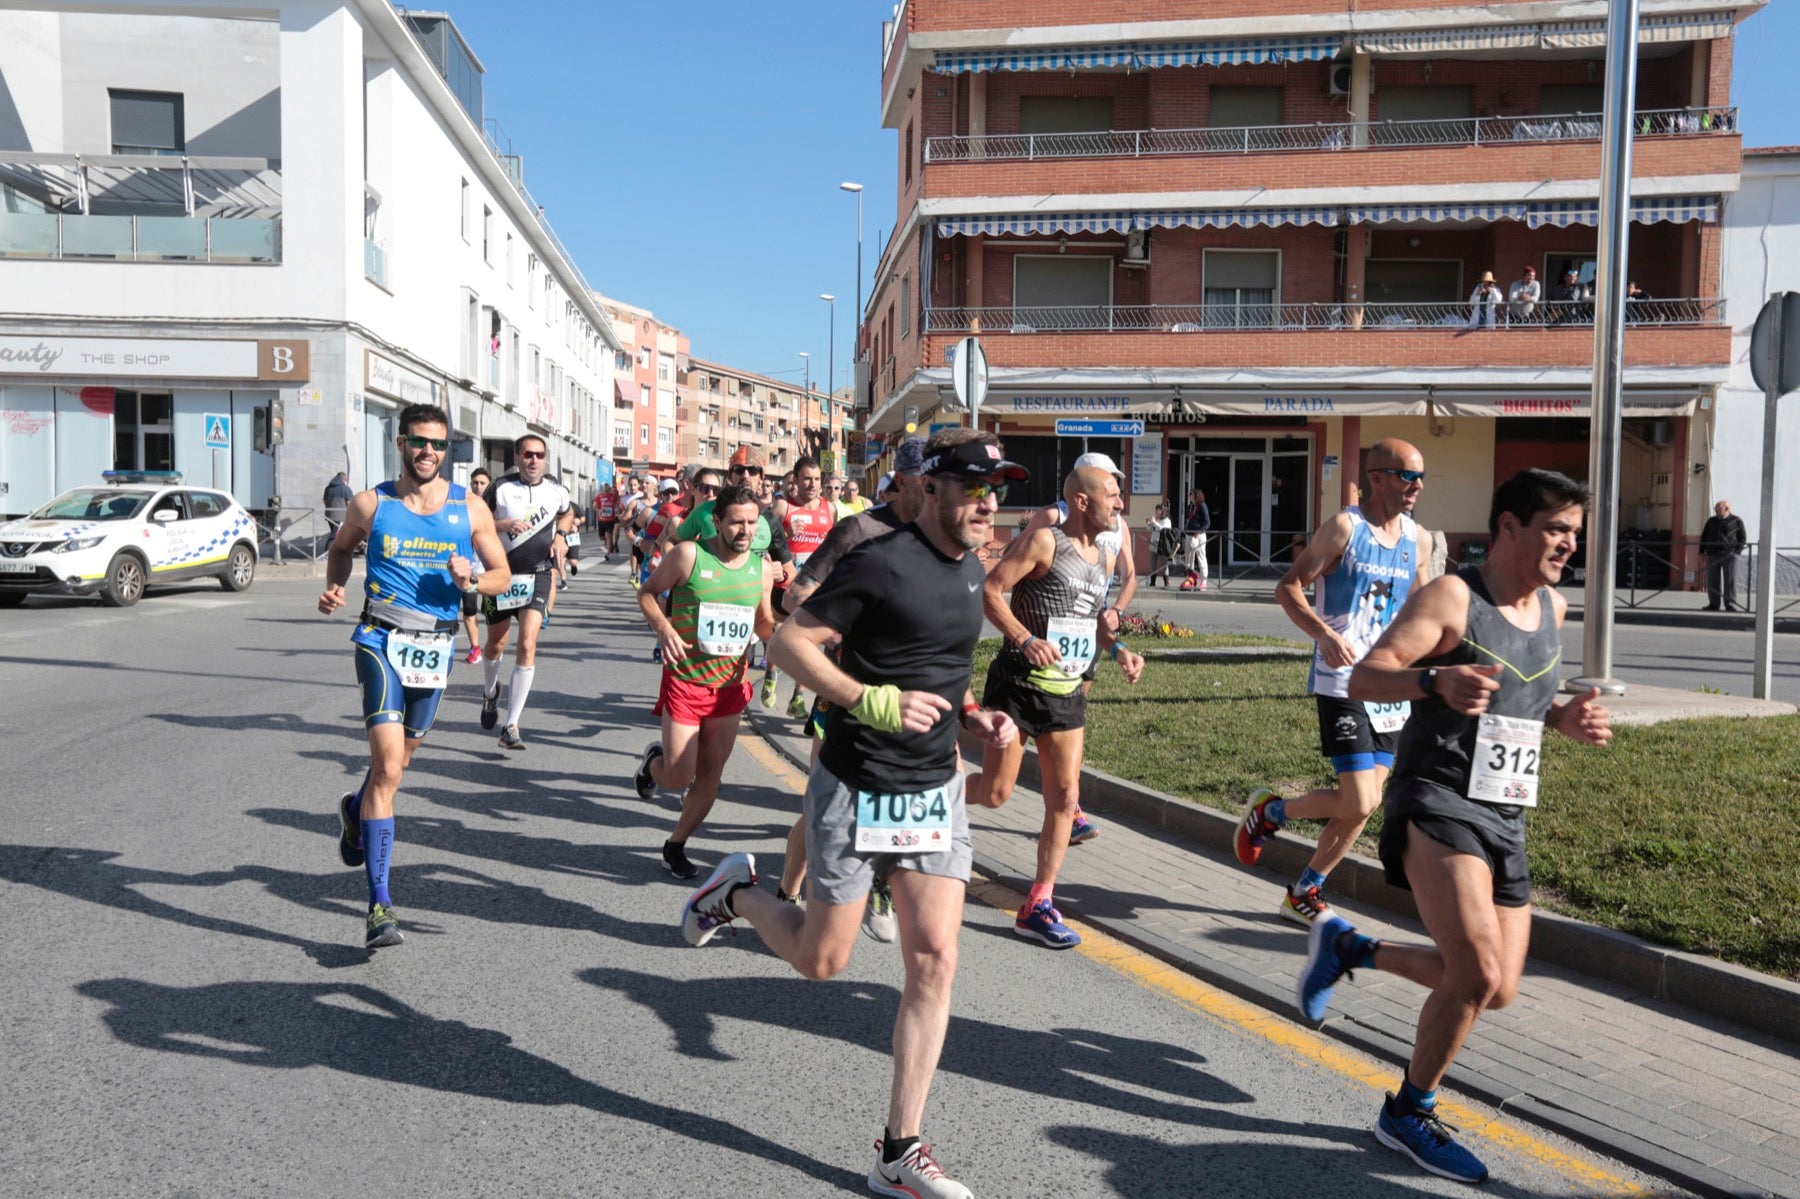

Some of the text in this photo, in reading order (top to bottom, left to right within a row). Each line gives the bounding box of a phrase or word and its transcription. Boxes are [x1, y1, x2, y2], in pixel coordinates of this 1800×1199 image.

[0, 341, 171, 371] auty THE SHOP
[271, 346, 295, 373] B
[1013, 396, 1130, 411] RESTAURANTE
[1263, 397, 1335, 411] PARADA
[1058, 423, 1094, 432] Granada
[1131, 411, 1207, 424] BICHITOS
[403, 537, 457, 553] olimpo
[1355, 562, 1388, 577] TODO
[706, 620, 749, 639] 1190
[1059, 636, 1089, 658] 812
[397, 646, 440, 670] 183
[1488, 743, 1537, 776] 312
[866, 787, 948, 823] 1064
[375, 828, 392, 885] Kalenji
